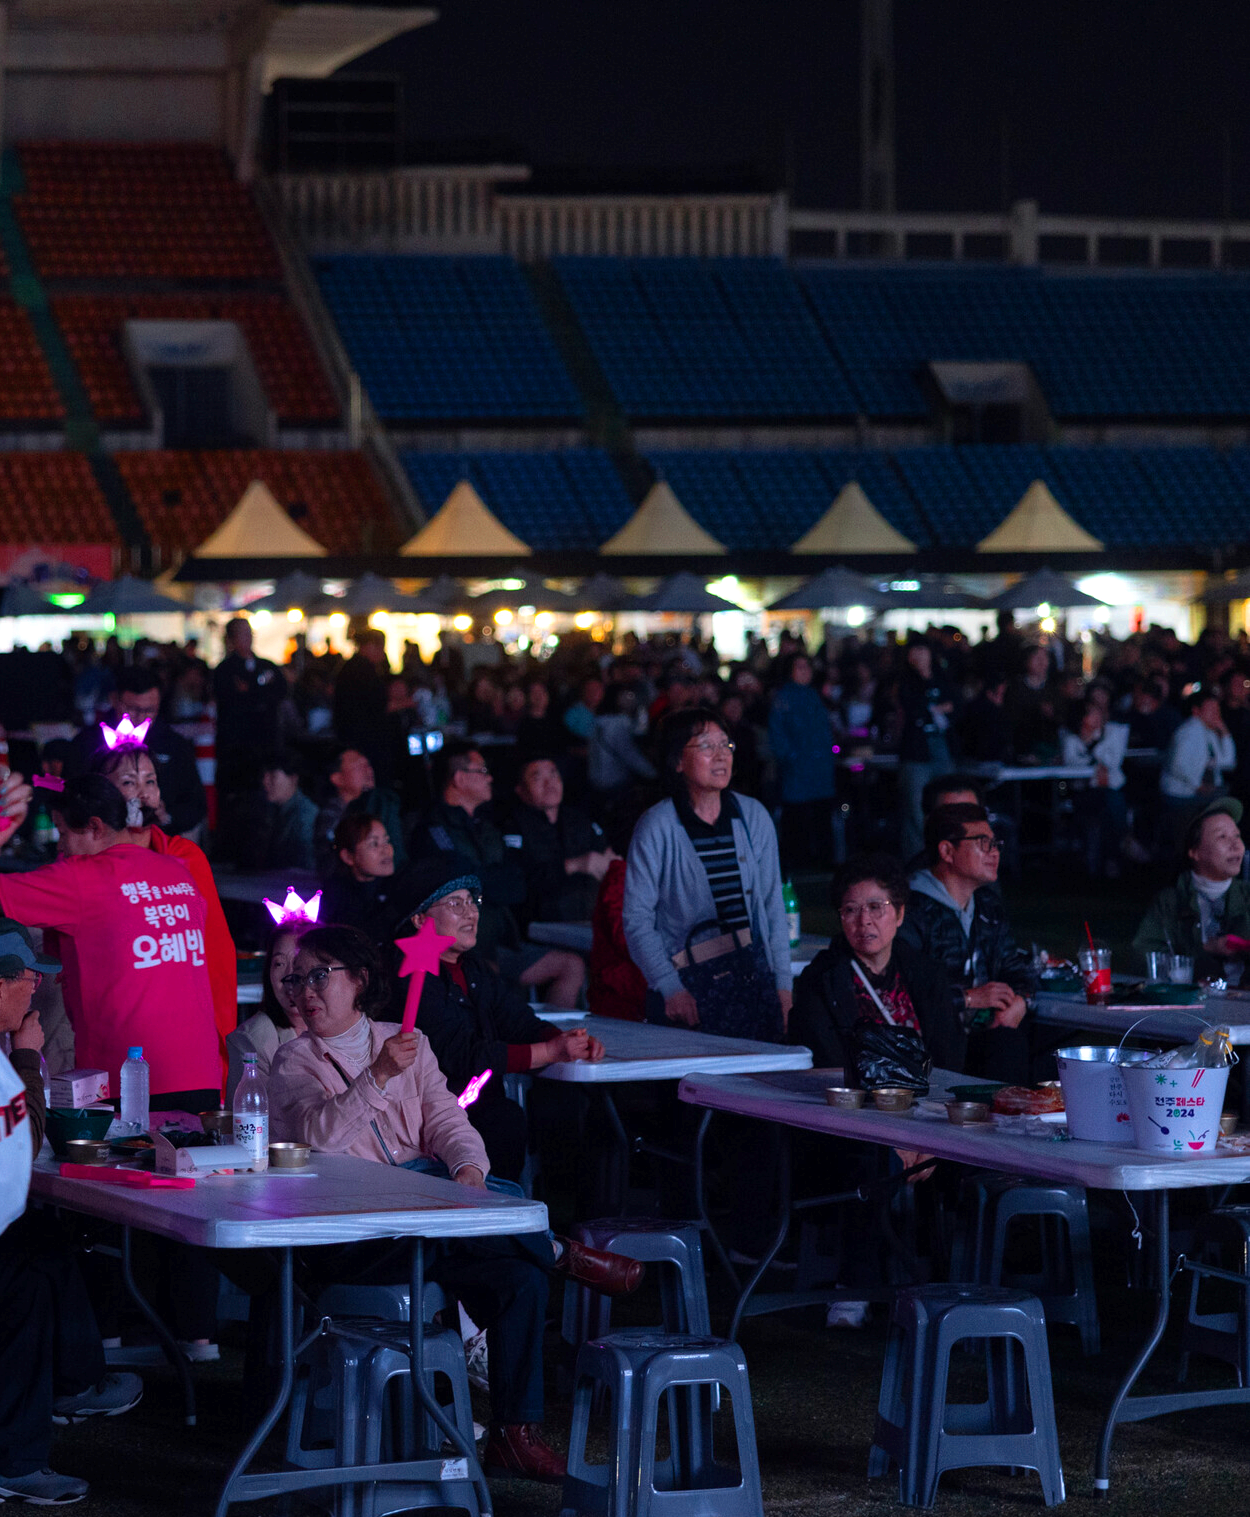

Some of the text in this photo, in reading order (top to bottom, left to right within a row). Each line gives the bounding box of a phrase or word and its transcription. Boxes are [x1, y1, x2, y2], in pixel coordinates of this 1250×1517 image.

[119, 880, 163, 905] 행복을
[143, 903, 191, 929] 복덩이
[131, 928, 206, 970] 오혜빈
[1154, 1096, 1206, 1107] 전주페스타
[1166, 1108, 1195, 1118] 2024
[238, 1123, 257, 1135] 전주
